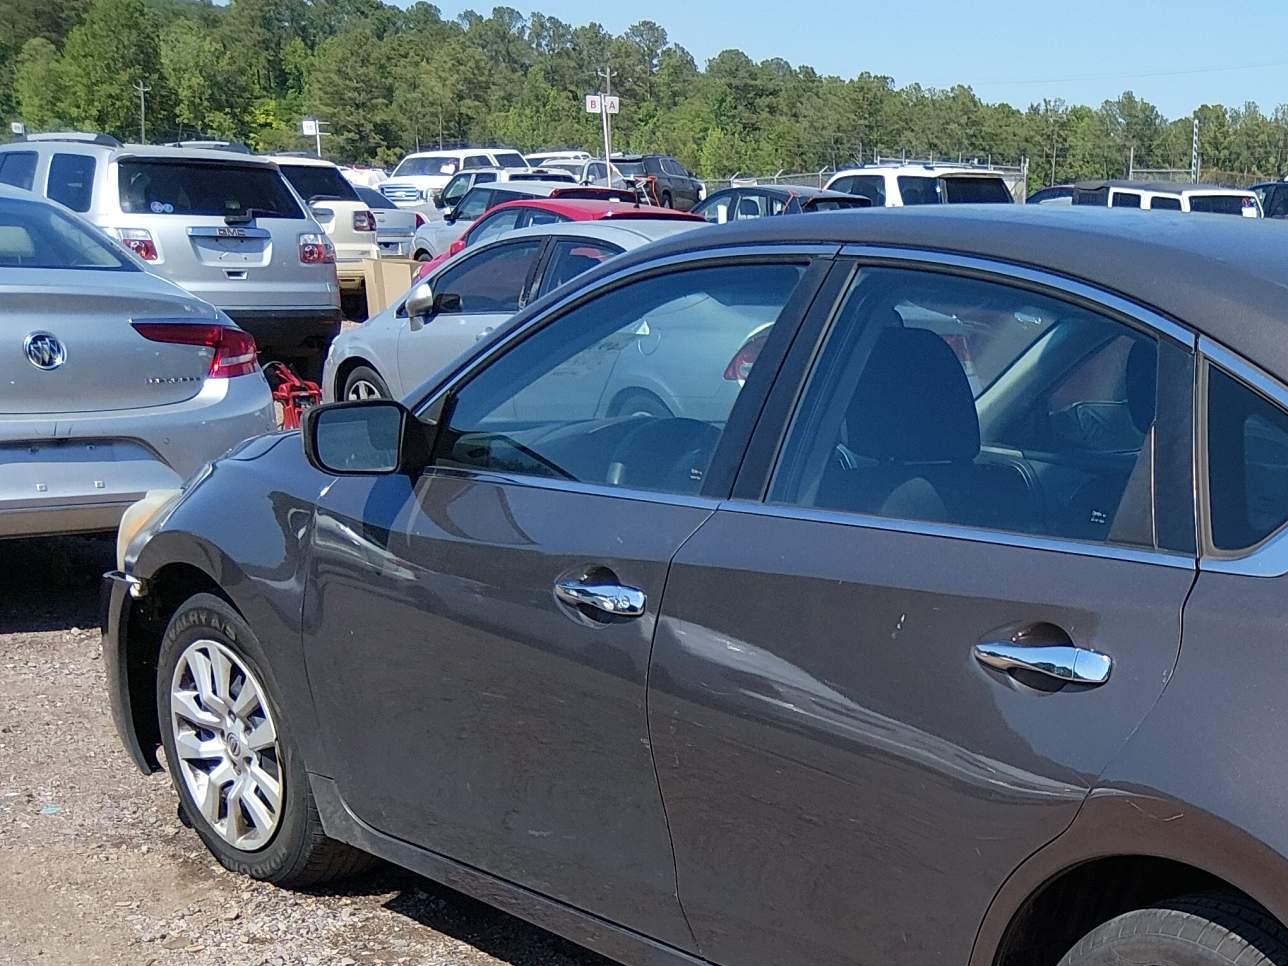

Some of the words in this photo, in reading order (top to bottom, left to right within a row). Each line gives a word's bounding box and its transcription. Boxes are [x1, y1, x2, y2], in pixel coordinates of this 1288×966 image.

[590, 100, 597, 109] B
[609, 101, 616, 110] A
[216, 227, 247, 237] GMC
